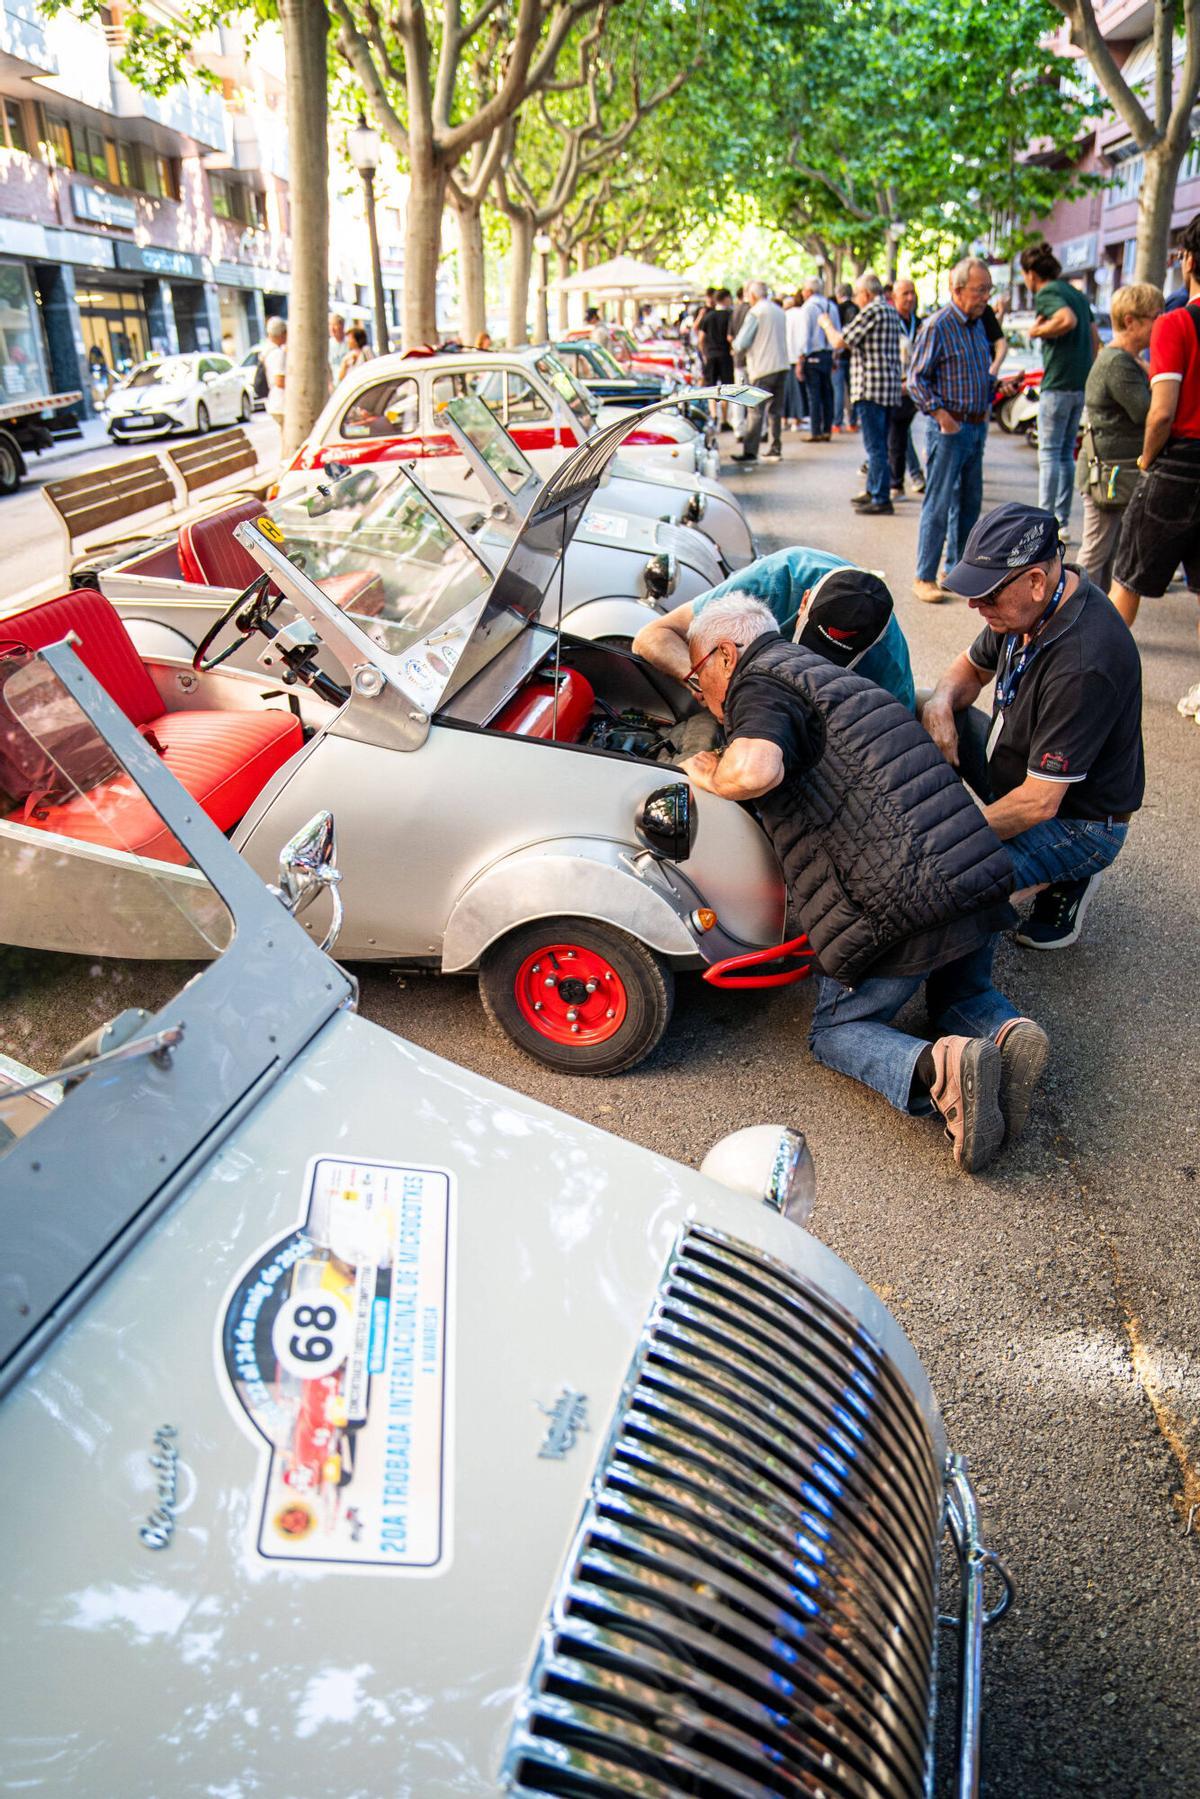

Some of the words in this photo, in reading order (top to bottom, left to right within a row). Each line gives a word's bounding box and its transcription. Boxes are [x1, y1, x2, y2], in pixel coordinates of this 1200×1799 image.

[398, 1175, 423, 1263] MICROCOTXES
[261, 1263, 284, 1285] de
[396, 1270, 419, 1286] DE
[234, 1319, 256, 1342] de
[289, 1304, 338, 1363] 68
[235, 1342, 256, 1363] 24
[388, 1292, 418, 1415] INTERNACIONAL
[382, 1423, 411, 1506] TROBADA
[380, 1514, 407, 1553] 20A
